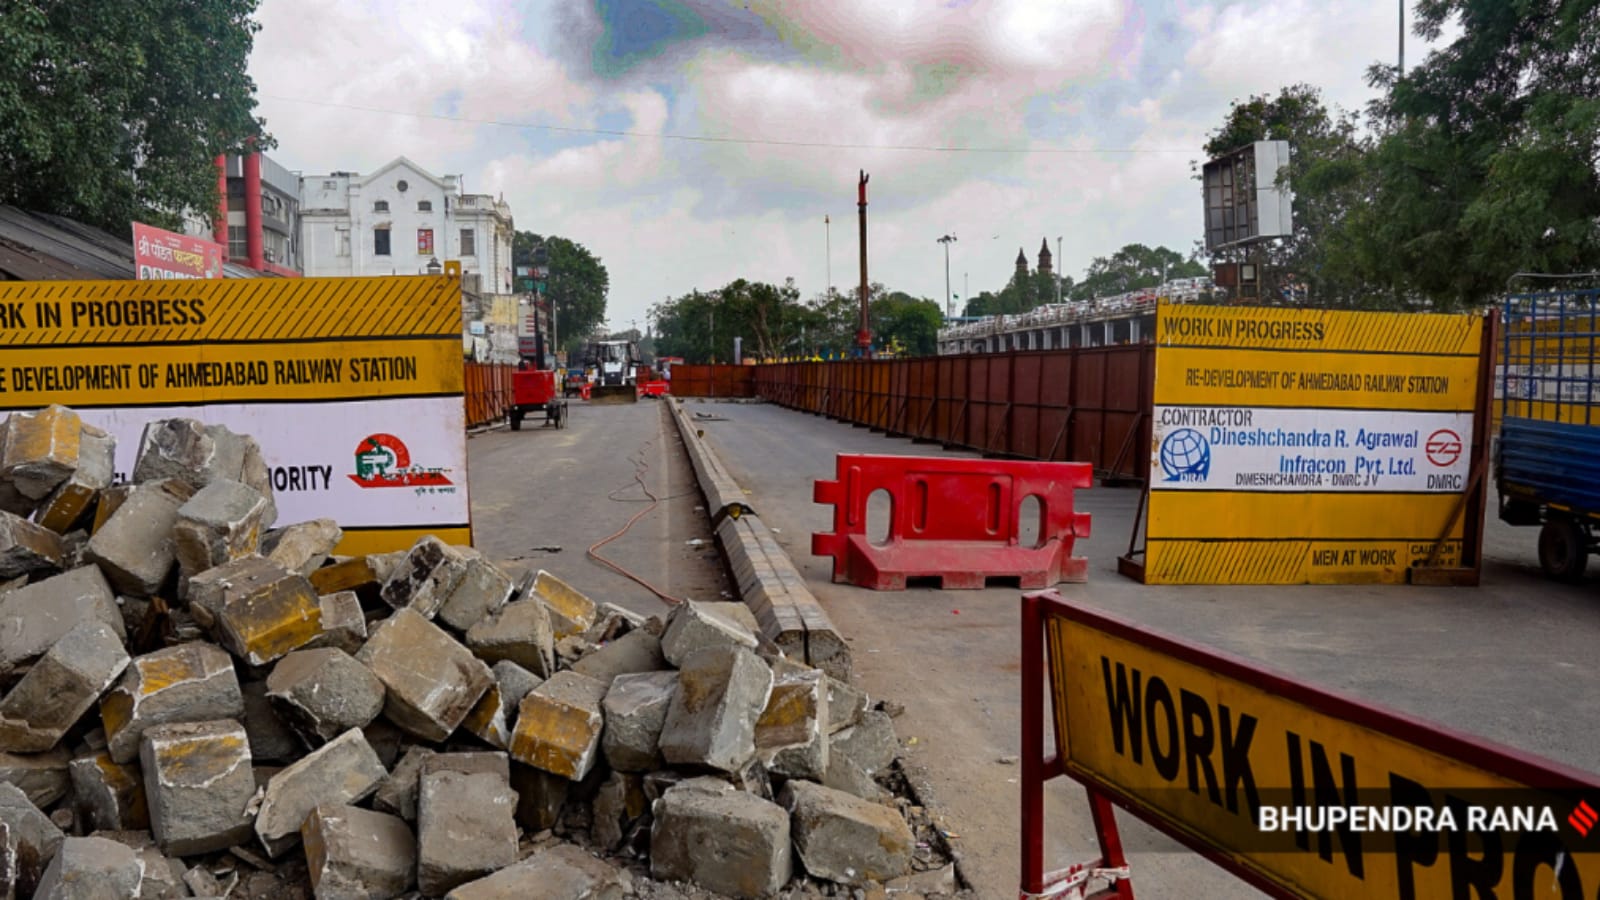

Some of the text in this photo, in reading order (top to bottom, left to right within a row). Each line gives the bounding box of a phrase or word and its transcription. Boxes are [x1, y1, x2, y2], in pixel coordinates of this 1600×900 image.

[36, 302, 61, 328] IN
[72, 300, 207, 327] PROGRESS
[1164, 317, 1325, 341] WORK IN PROGRESS
[12, 365, 131, 392] DEVELOPMENT
[139, 364, 159, 389] OF
[166, 360, 269, 388] AHMEDABAD
[274, 359, 343, 384] RAILWAY
[350, 356, 417, 381] STATION
[1185, 368, 1449, 394] RE-DEVELOPMENT OF AHMEDABAD RAILWAY STATION
[1162, 408, 1253, 427] CONTRACTOR
[1210, 426, 1419, 451] Dineshchandra R. Agrawal
[1280, 455, 1416, 475] Infracon Pvt. Ltd.
[1235, 473, 1322, 486] DINESHCHANDRA
[1332, 474, 1361, 486] DMRC
[1427, 474, 1461, 489] DMRC
[1312, 550, 1338, 566] MEN
[1342, 550, 1357, 566] AT
[1360, 550, 1396, 566] WORK
[1101, 655, 1261, 826] WORK
[1286, 729, 1365, 881] IN
